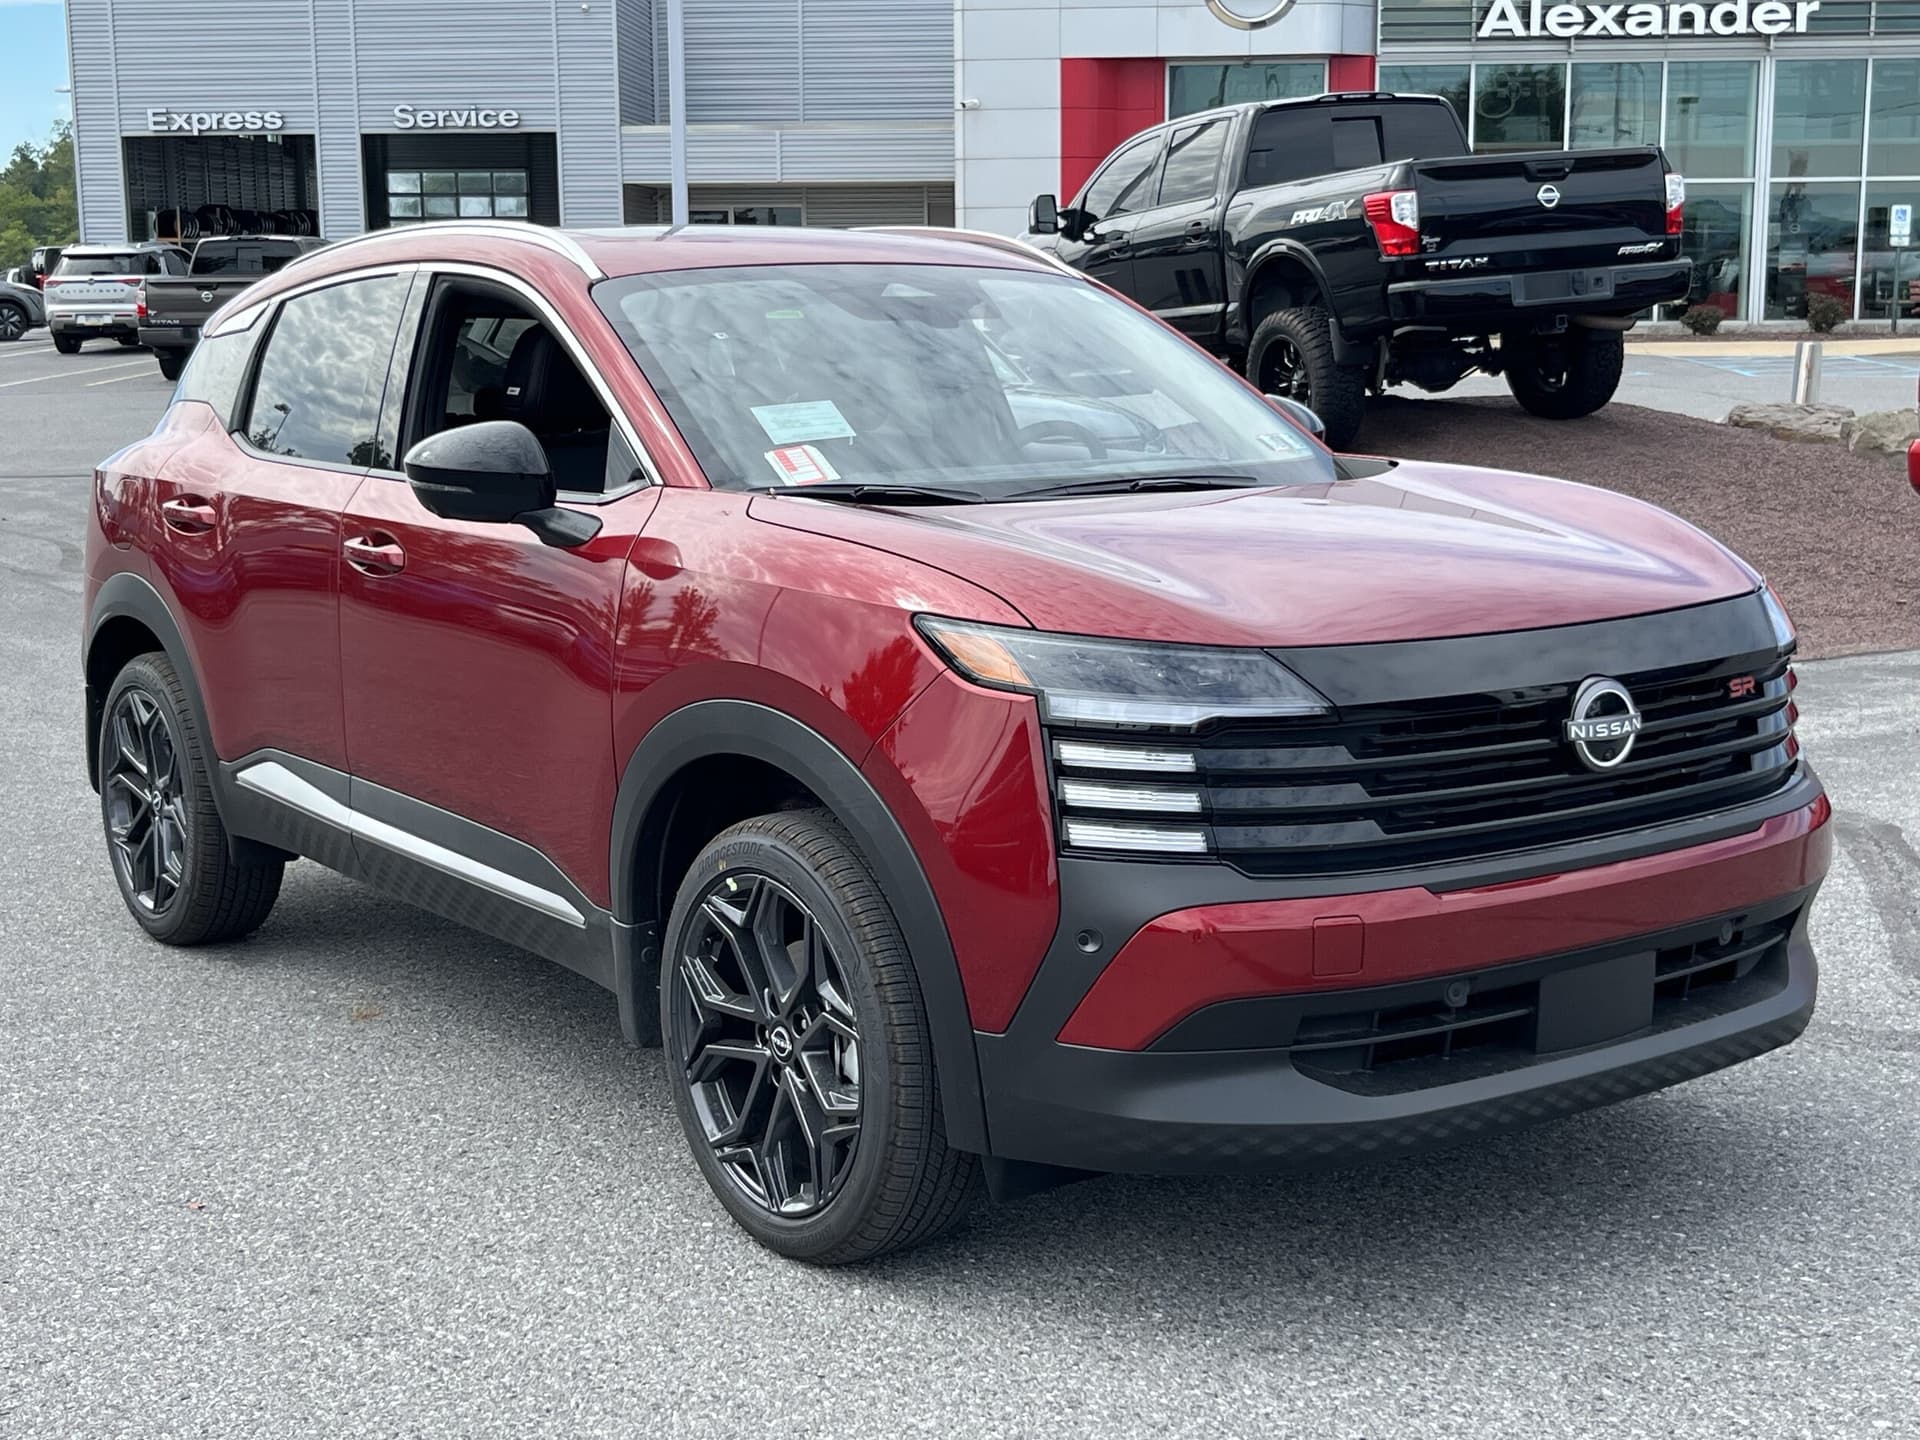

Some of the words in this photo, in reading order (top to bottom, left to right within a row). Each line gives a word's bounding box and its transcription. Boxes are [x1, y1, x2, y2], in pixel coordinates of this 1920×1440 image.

[1477, 0, 1819, 38] Alexander
[146, 107, 284, 135] Express
[393, 104, 520, 129] Service
[1425, 256, 1489, 272] TITAN
[1729, 676, 1756, 699] SR
[1570, 716, 1642, 739] NISSAN
[698, 841, 765, 878] BRIDGESTONE
